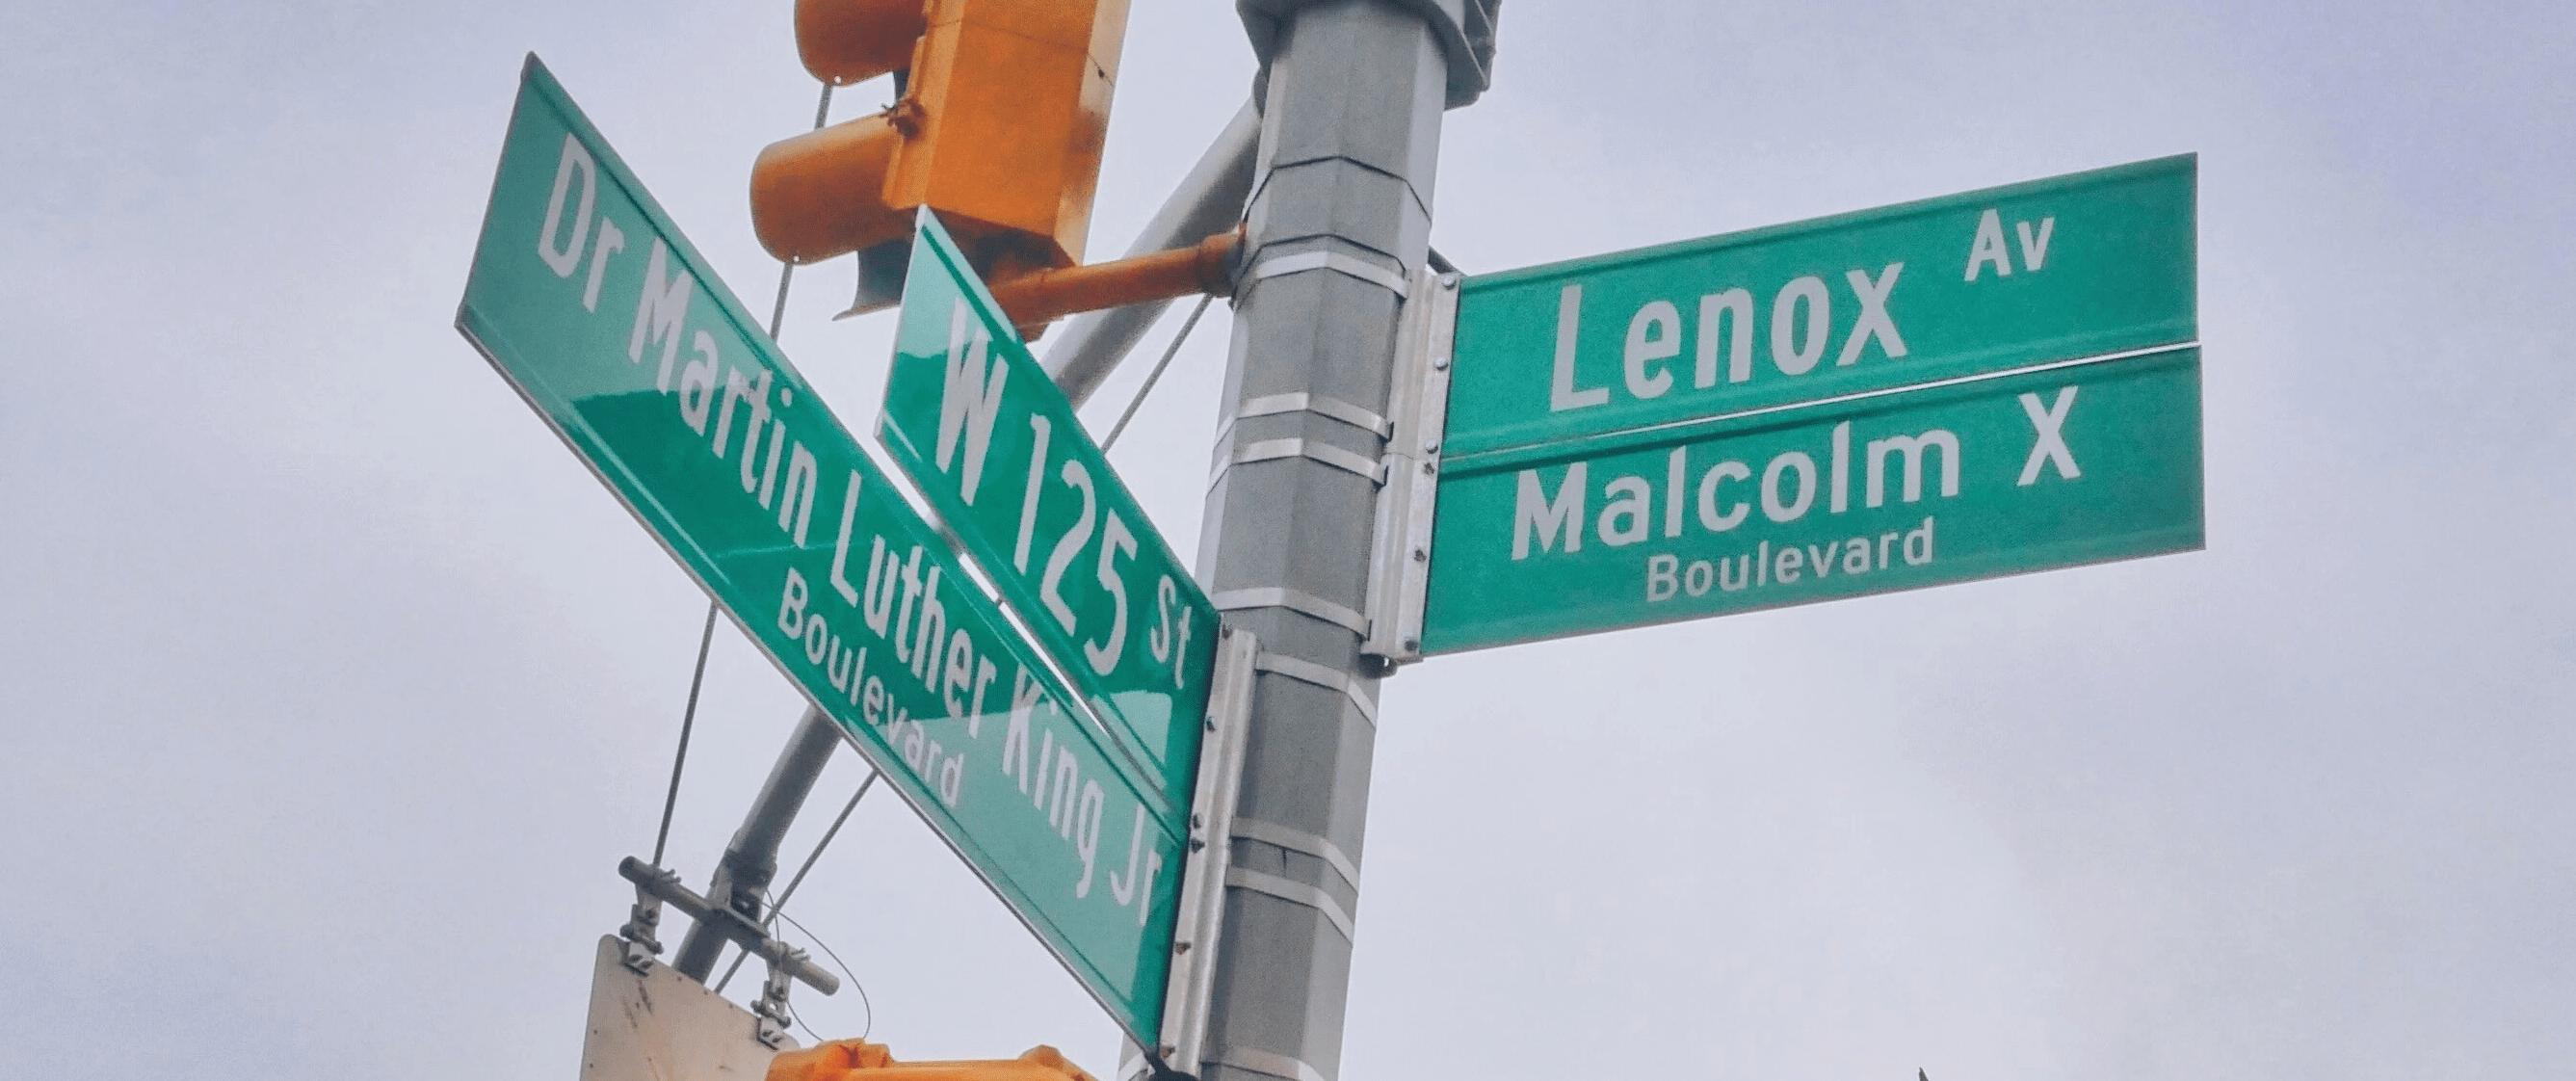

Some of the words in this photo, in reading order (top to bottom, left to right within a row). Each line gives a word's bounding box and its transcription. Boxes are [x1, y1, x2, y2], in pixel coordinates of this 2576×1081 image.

[1550, 261, 1907, 412] Lenox
[1963, 208, 2055, 282] Av
[538, 132, 625, 313] Dr
[628, 235, 819, 548] Martin
[830, 470, 996, 738] Luther
[1002, 664, 1105, 899] King
[1110, 802, 1162, 926] Jr
[935, 298, 1010, 506] W
[1014, 414, 1138, 675] 125
[1150, 577, 1194, 689] St
[1511, 420, 1960, 561] Malcolm
[2016, 386, 2082, 488] X
[1646, 518, 1934, 604] Boulevard
[777, 567, 964, 807] Boulevard
